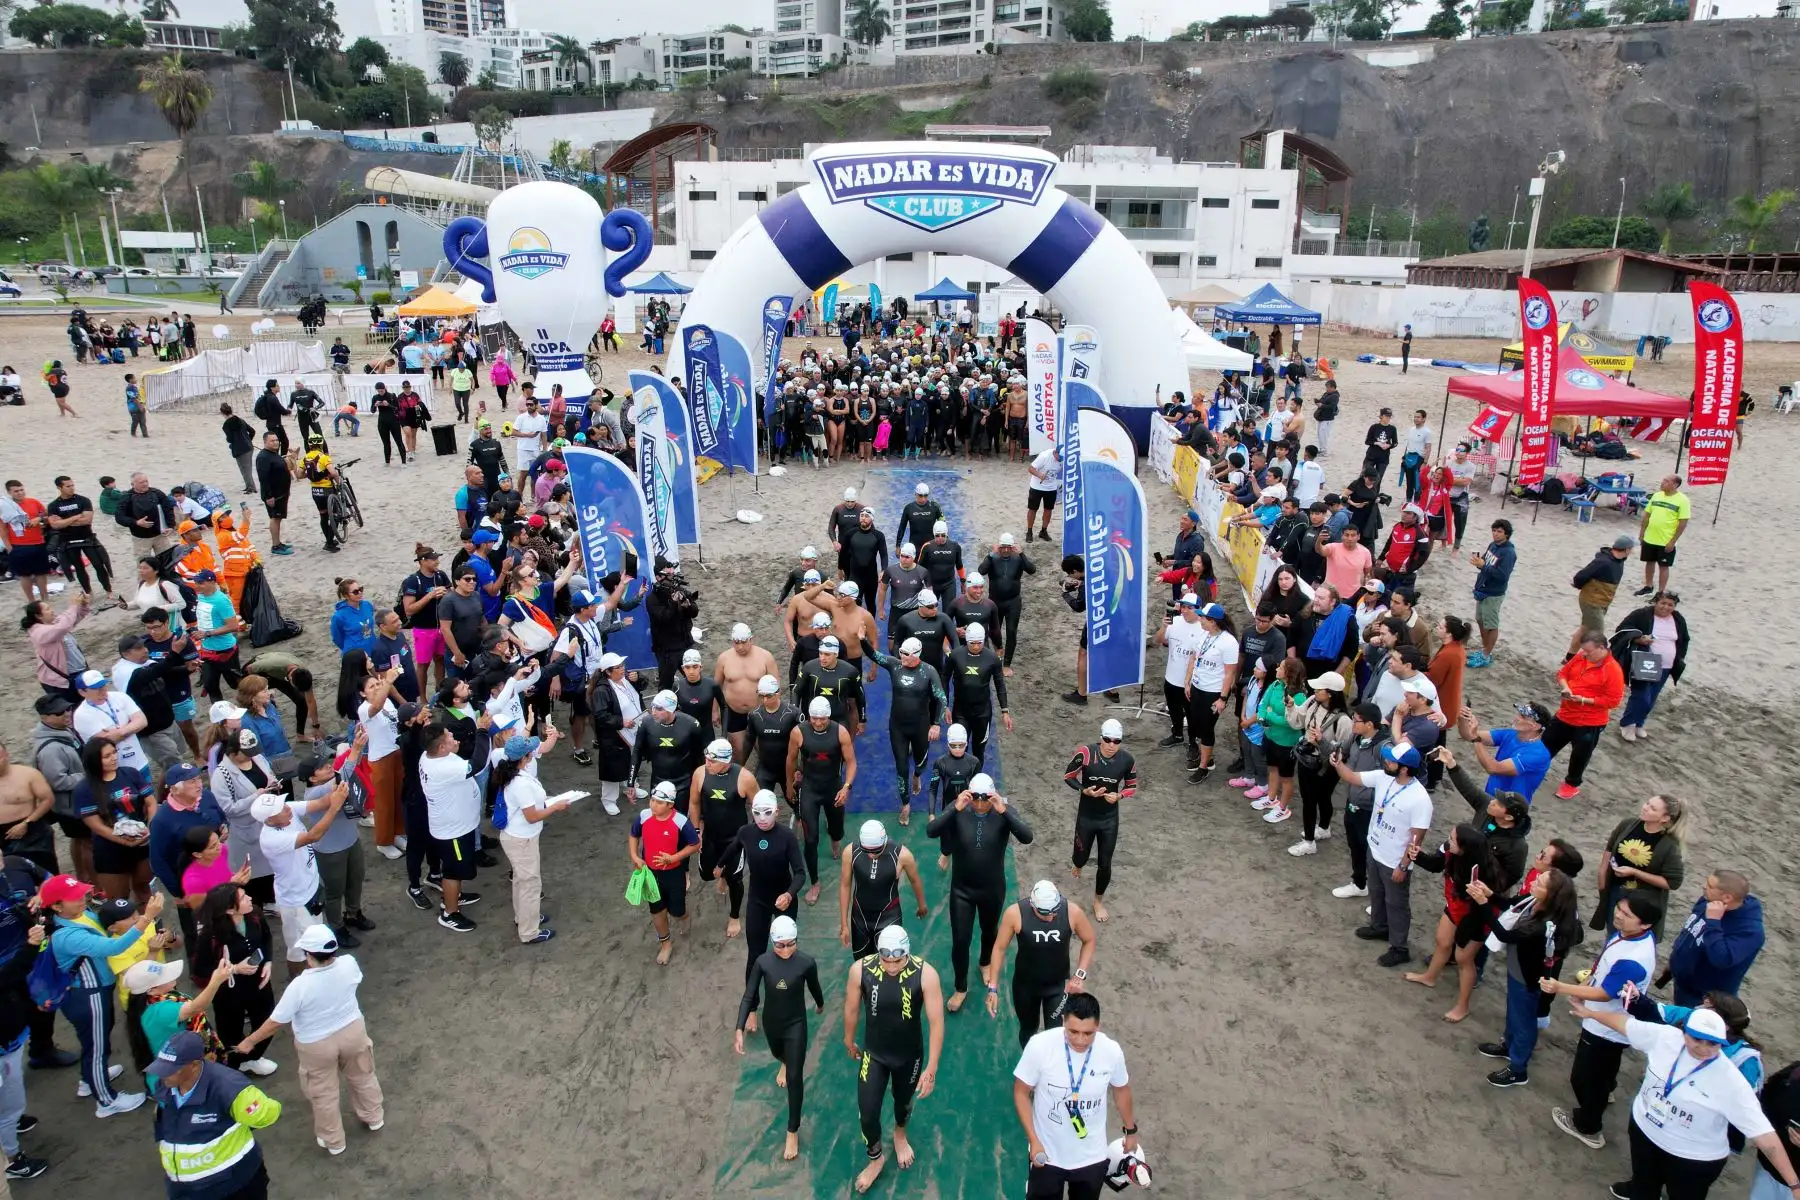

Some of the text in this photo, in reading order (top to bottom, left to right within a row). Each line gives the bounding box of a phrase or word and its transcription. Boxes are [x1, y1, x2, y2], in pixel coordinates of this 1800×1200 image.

[833, 160, 1035, 192] NADAR ES VIDA
[903, 197, 964, 217] CLUB
[502, 255, 528, 267] NADAR
[540, 255, 563, 265] VIDA
[530, 341, 572, 354] COPA
[766, 330, 774, 355] VIDA
[1588, 358, 1626, 366] SWIMMING
[1530, 346, 1540, 412] NATACIÓN
[1540, 334, 1552, 422] ACADEMIA DE
[1702, 349, 1717, 415] NATACIÓN
[1717, 338, 1736, 426] ACADEMIA DE
[694, 362, 714, 447] NADAR ES VIDA
[1034, 384, 1044, 434] AGUAS
[1044, 372, 1054, 442] ABIERTAS
[1524, 425, 1549, 435] OCEAN
[1691, 429, 1734, 438] OCEAN
[1528, 437, 1545, 446] SWIM
[1694, 440, 1726, 449] SWIM
[643, 441, 652, 484] VIDA
[1088, 776, 1118, 784] orca
[1032, 929, 1061, 943] TYR
